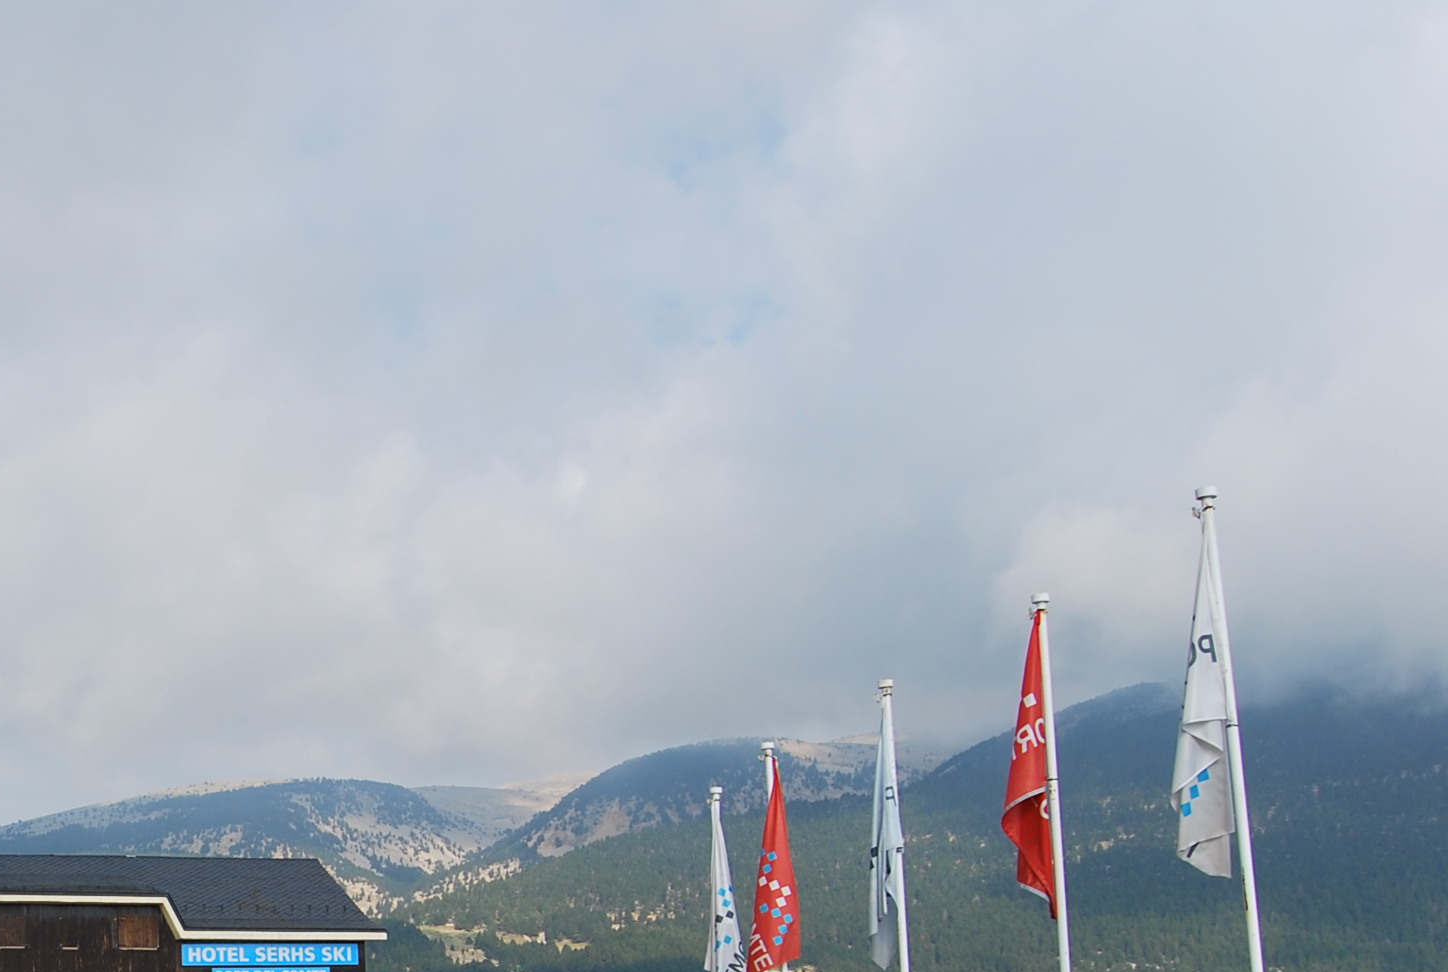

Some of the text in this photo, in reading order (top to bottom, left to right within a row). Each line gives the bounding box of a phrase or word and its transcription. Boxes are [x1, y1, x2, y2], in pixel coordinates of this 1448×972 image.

[188, 946, 352, 962] HOTEL SERHS SKI
